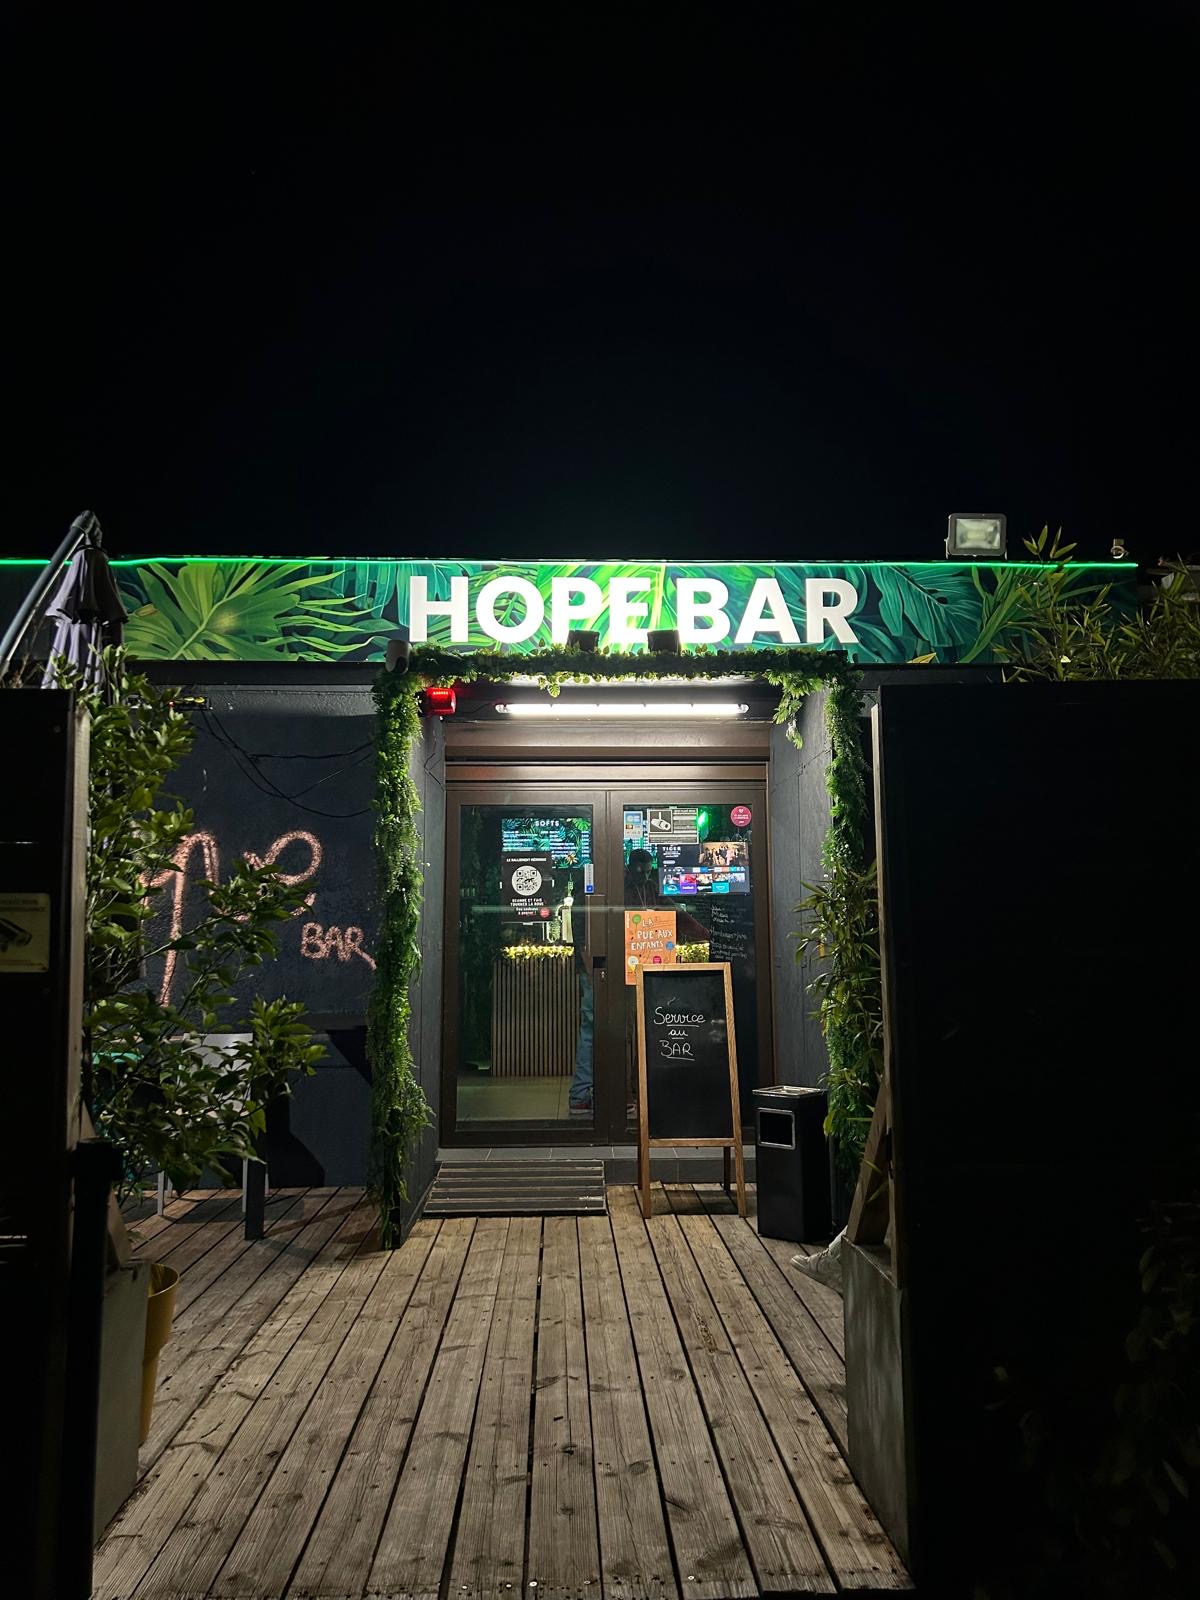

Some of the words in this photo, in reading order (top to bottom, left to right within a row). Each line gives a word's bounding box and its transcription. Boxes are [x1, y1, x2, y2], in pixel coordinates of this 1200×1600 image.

[409, 575, 650, 644] HOPE
[676, 577, 859, 644] BAR
[642, 917, 654, 927] LA
[657, 929, 673, 939] AUX
[300, 922, 377, 972] BAR
[631, 940, 664, 951] ENFANTS
[653, 1006, 706, 1025] Service
[668, 1029, 689, 1037] au
[659, 1039, 694, 1057] BAR
